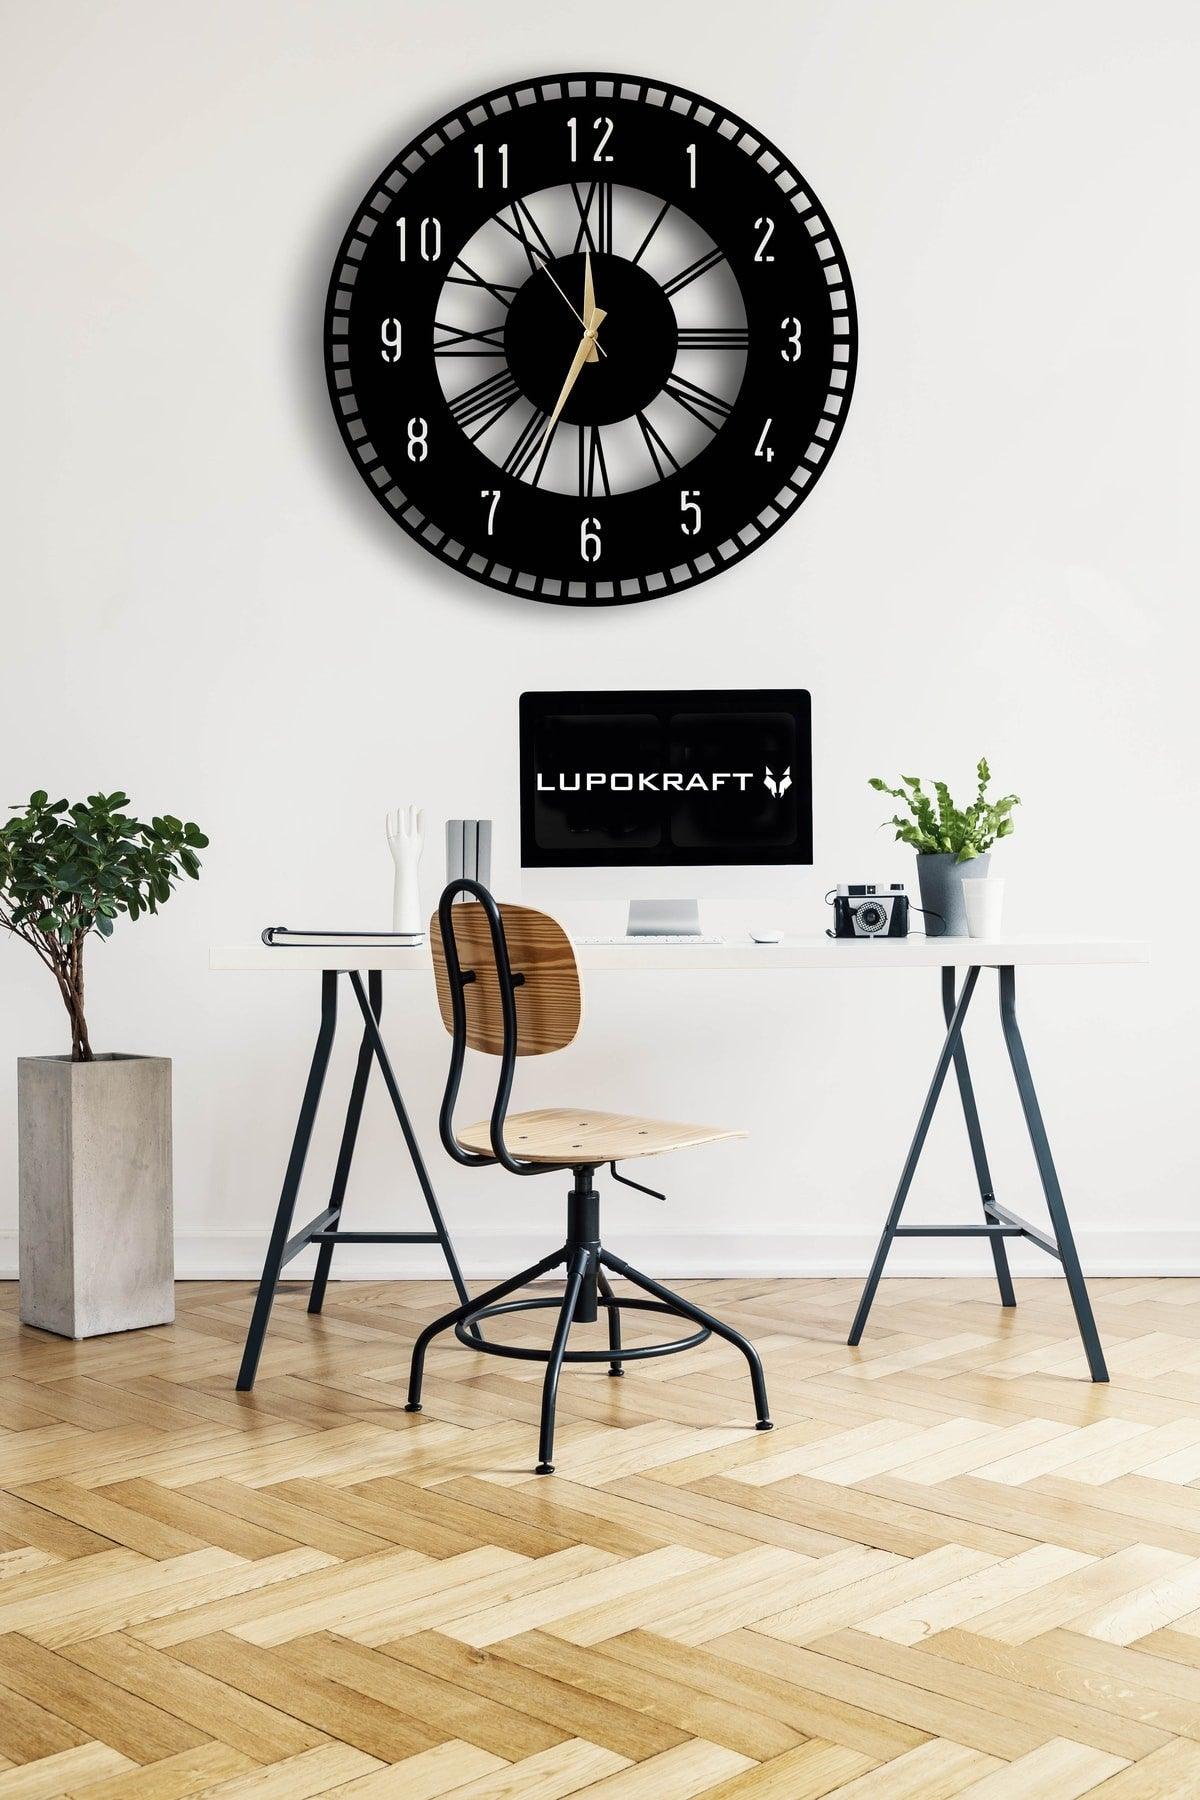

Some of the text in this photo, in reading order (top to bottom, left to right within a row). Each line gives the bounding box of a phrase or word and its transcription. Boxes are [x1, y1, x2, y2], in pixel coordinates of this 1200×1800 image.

[567, 118, 613, 162] 12
[474, 144, 508, 189] 11
[686, 144, 696, 189] 1
[397, 217, 442, 262] 10
[754, 218, 775, 262] 2
[381, 318, 402, 362] 9
[780, 318, 802, 362] 3
[407, 418, 428, 462] 8
[754, 418, 775, 463] 4
[480, 490, 501, 535] 7
[680, 490, 702, 535] 5
[580, 517, 602, 562] 6
[537, 773, 754, 791] LUPOKRAFT
